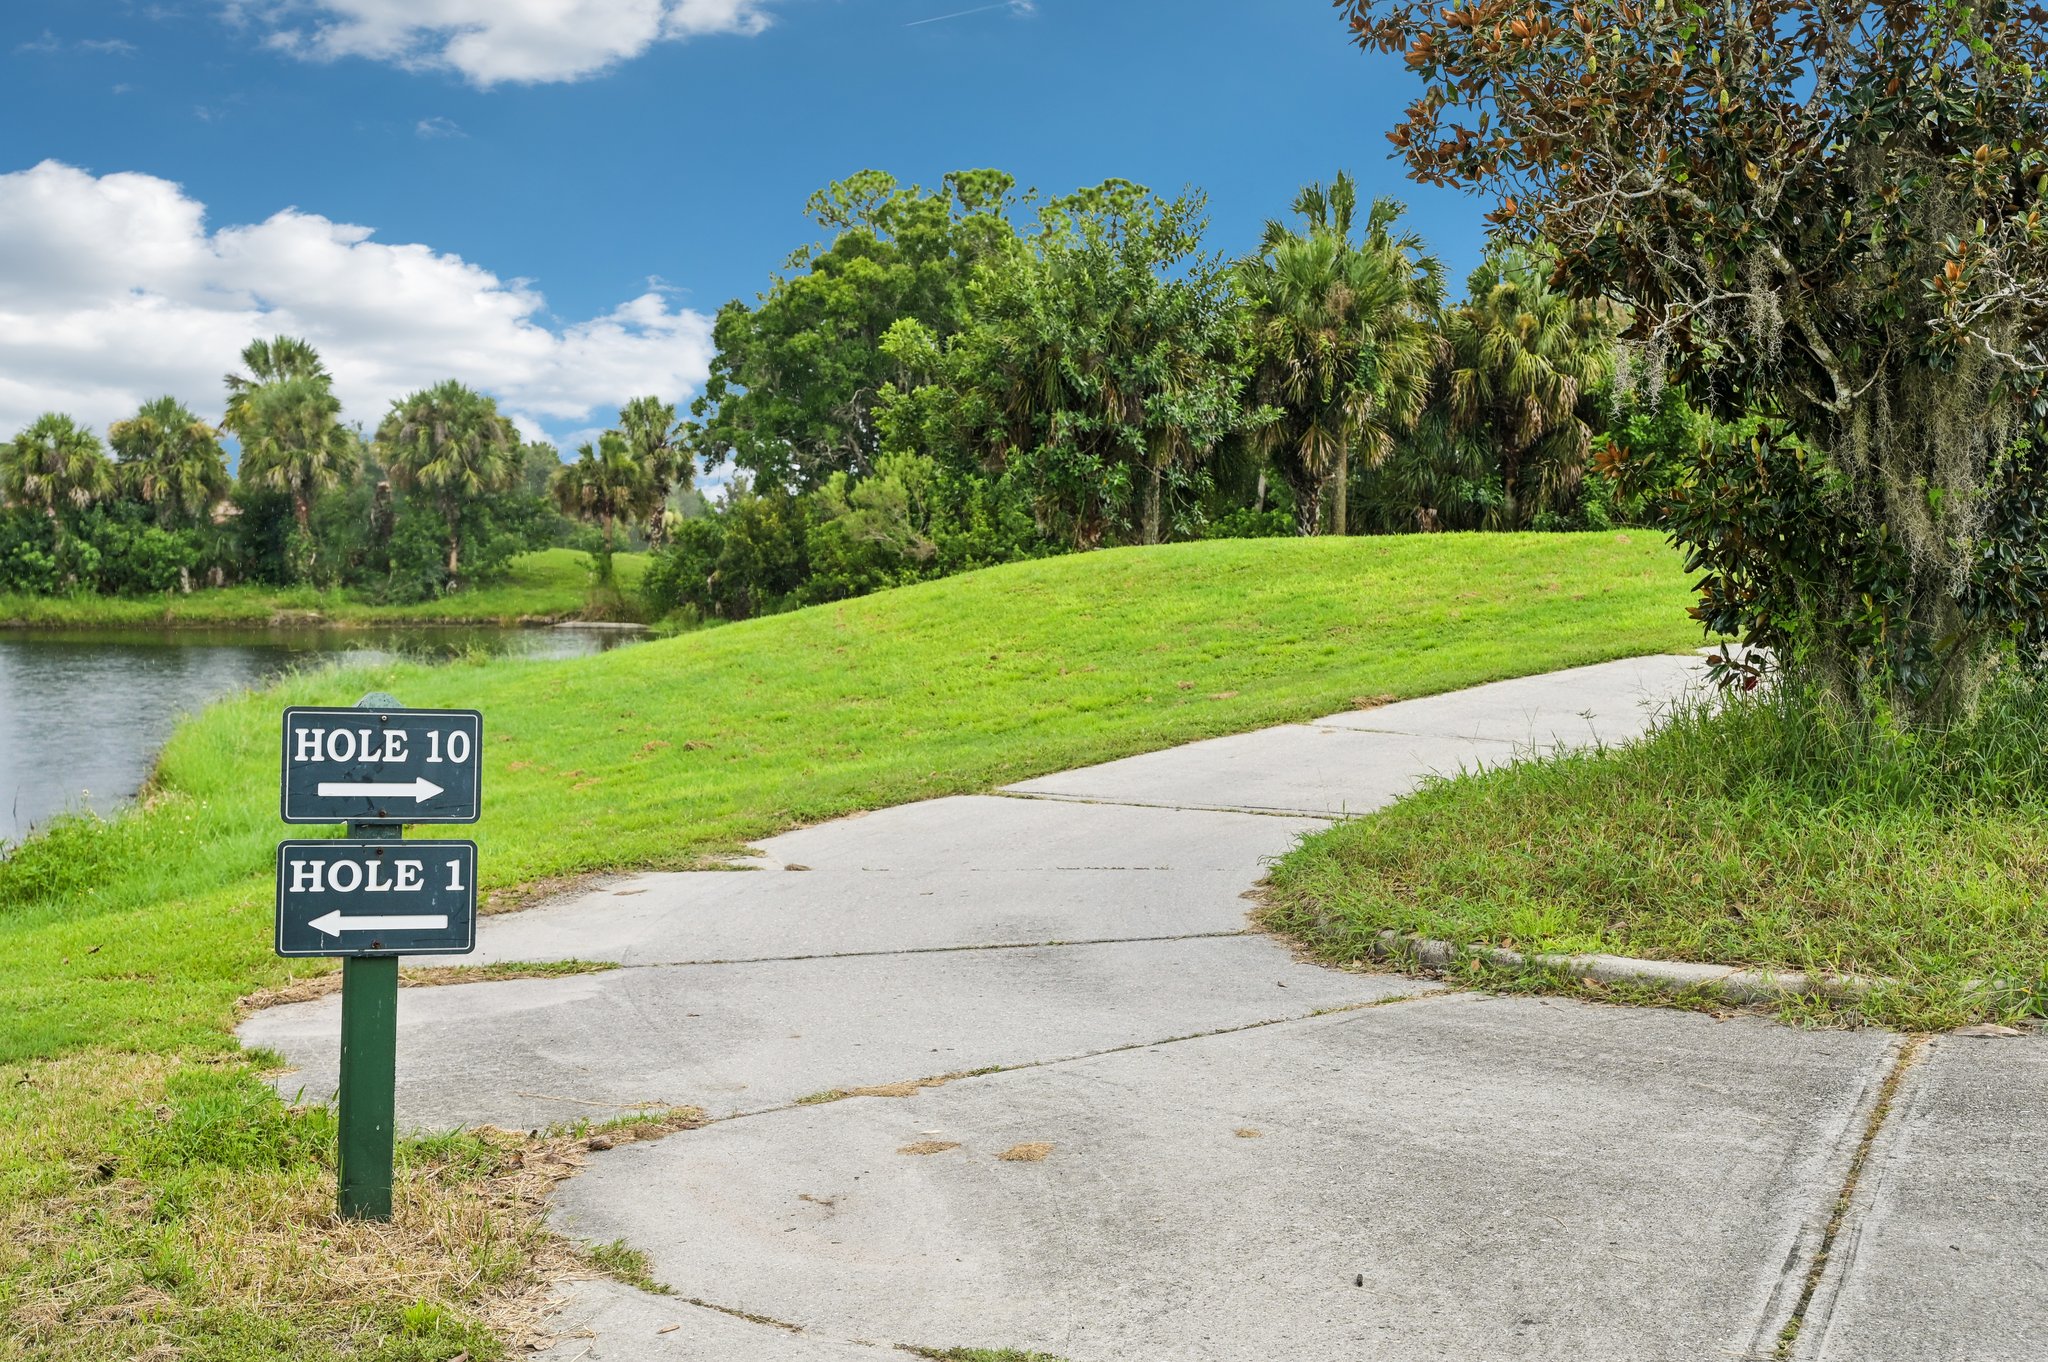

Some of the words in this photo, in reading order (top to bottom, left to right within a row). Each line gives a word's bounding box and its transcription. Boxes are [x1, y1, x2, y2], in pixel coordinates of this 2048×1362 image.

[294, 728, 409, 762] HOLE
[425, 729, 471, 764] 10
[289, 860, 425, 893] HOLE
[445, 859, 466, 891] 1
